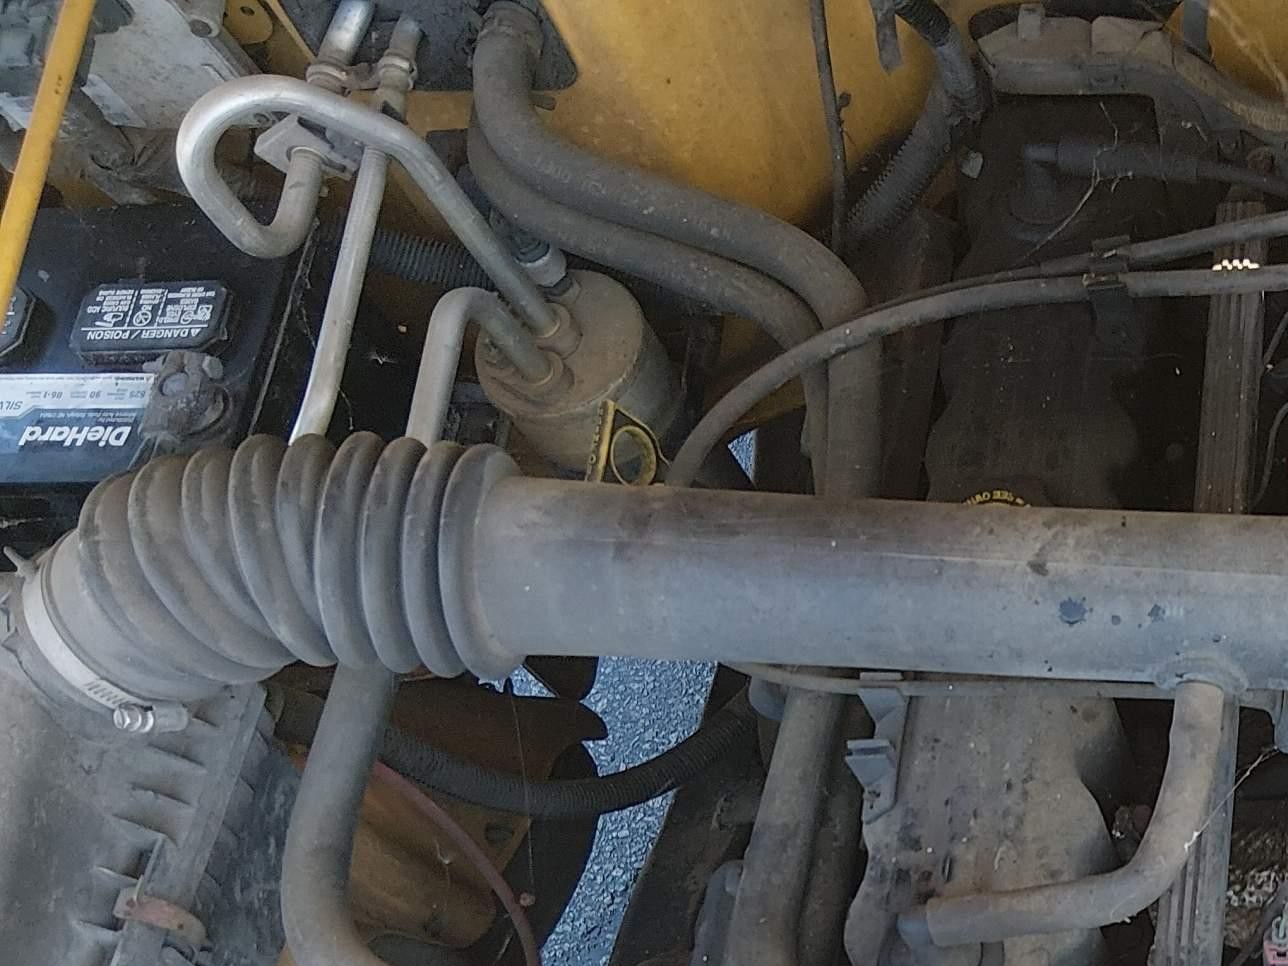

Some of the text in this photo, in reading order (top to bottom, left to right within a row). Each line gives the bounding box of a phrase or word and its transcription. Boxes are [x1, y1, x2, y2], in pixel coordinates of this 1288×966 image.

[86, 329, 130, 340] POISON
[140, 328, 189, 339] DANGER
[18, 425, 132, 447] DieHard
